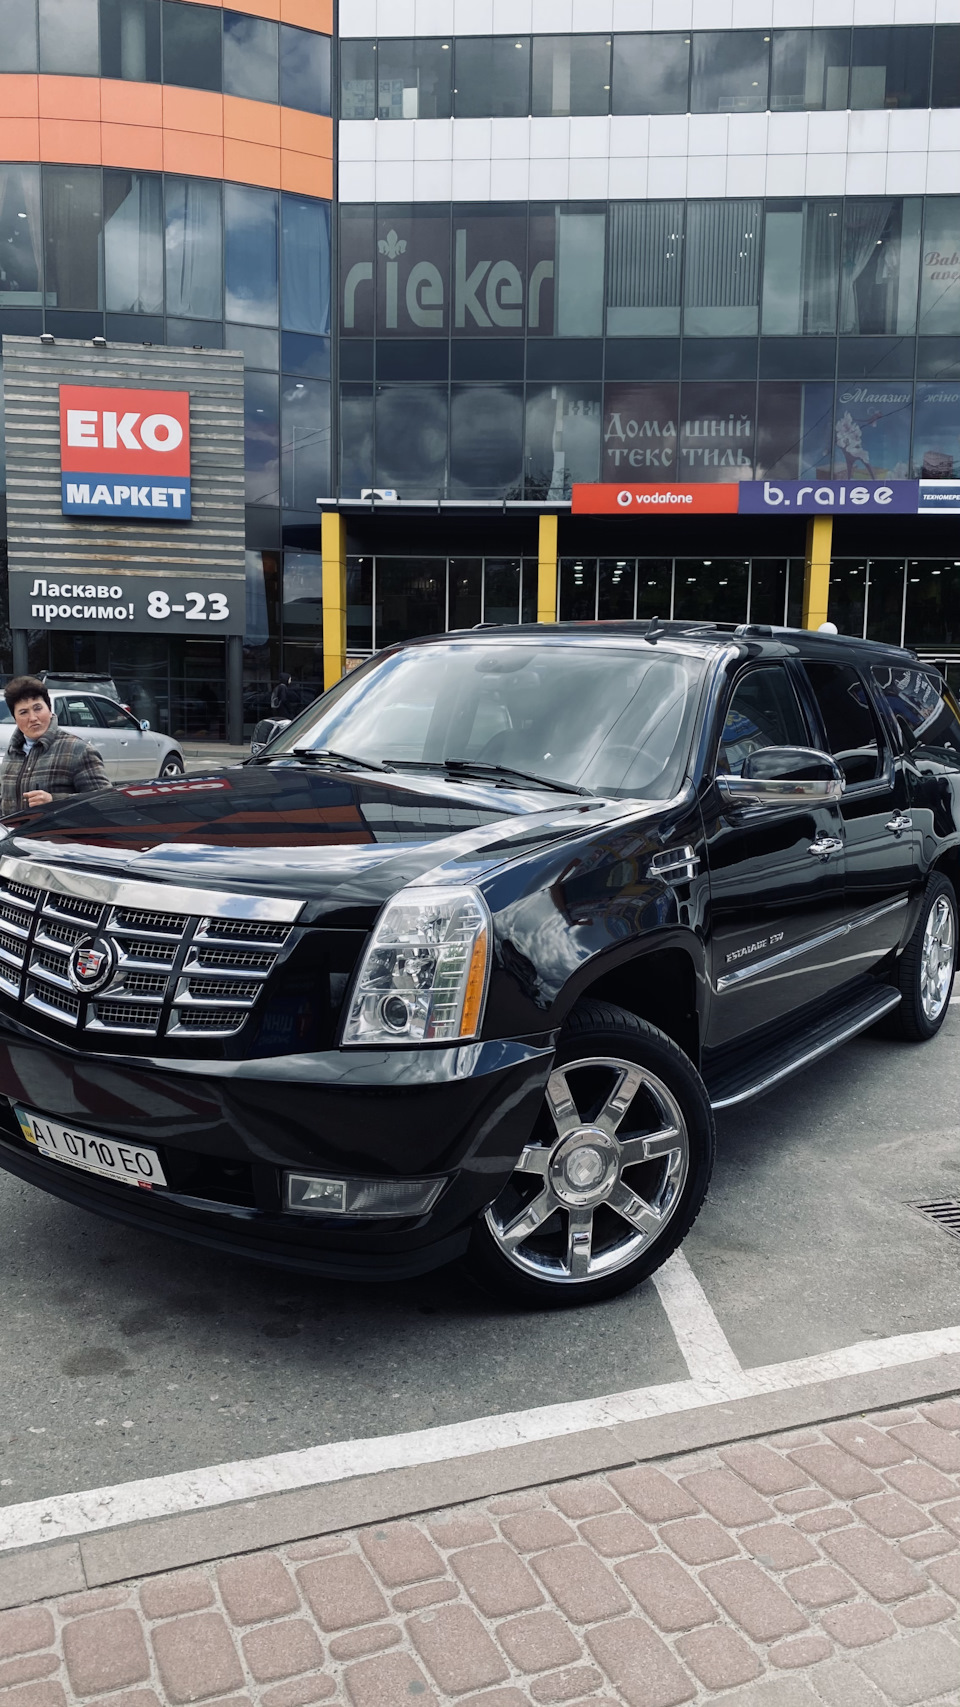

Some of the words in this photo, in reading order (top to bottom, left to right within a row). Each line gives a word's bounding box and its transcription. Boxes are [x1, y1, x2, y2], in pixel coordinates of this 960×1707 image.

[924, 251, 960, 266] Bab
[344, 229, 554, 328] rieker
[839, 387, 911, 404] Магазин
[66, 409, 184, 452] ЕКО
[66, 483, 187, 508] МАРКЕТ
[635, 491, 694, 504] vodafone
[763, 481, 894, 506] b.raise
[29, 579, 123, 599] Ласкаво
[31, 603, 135, 623] просимо!
[147, 590, 230, 621] 8-23
[63, 1131, 115, 1168] 0710
